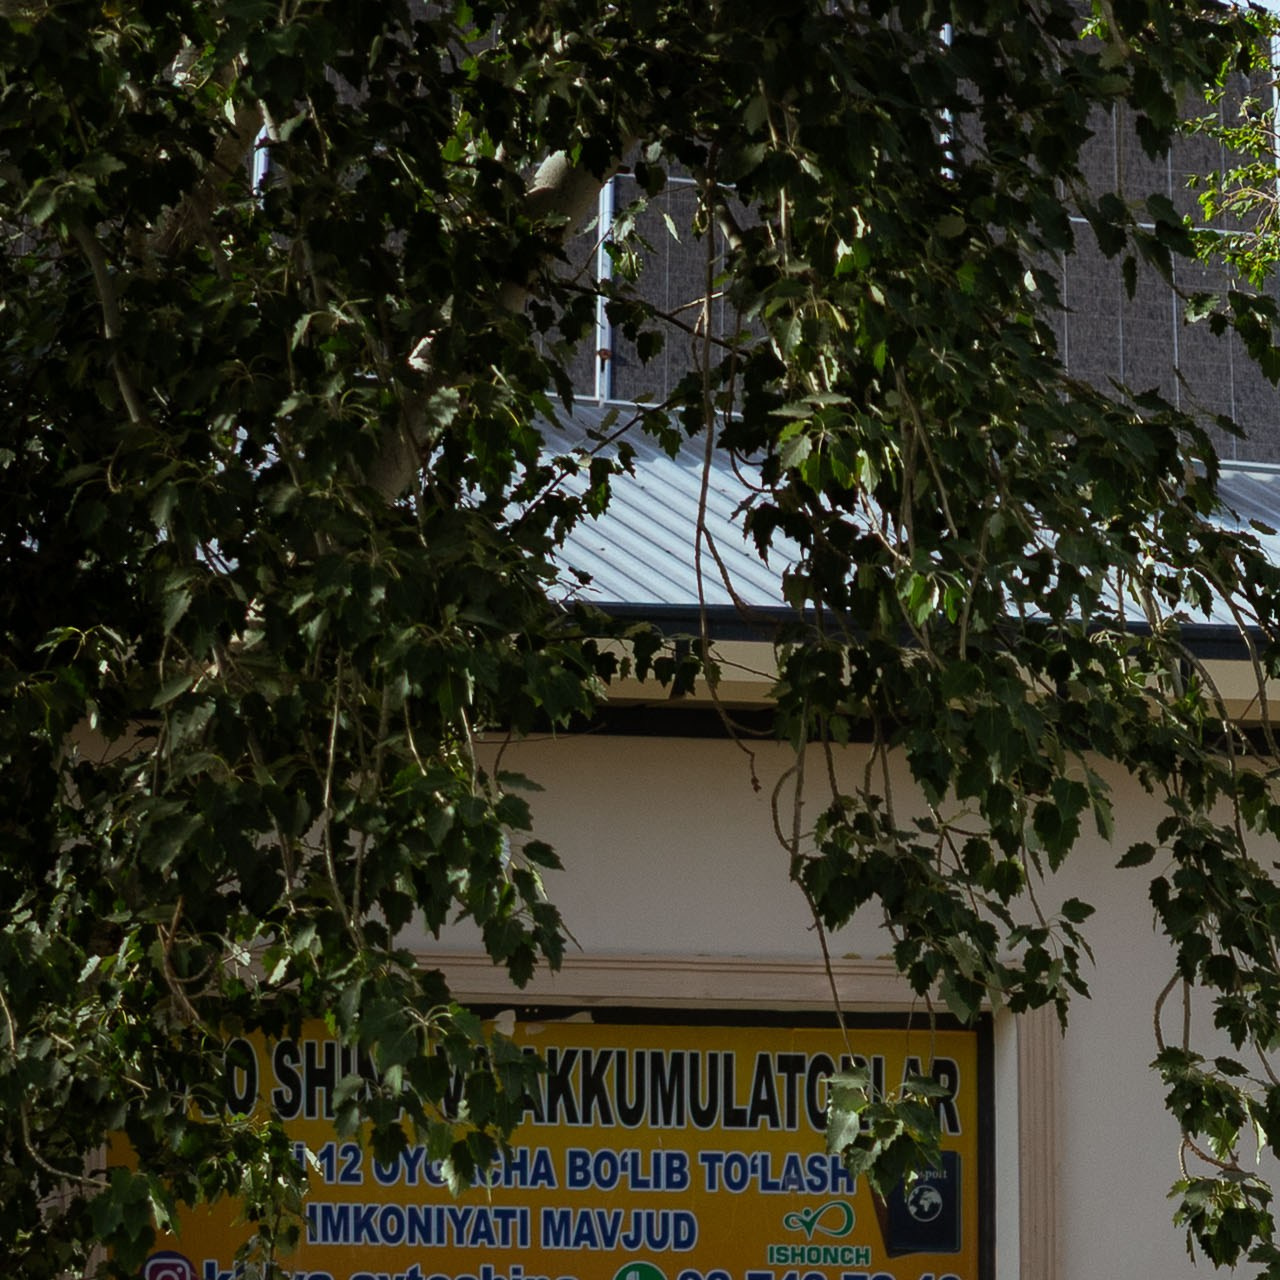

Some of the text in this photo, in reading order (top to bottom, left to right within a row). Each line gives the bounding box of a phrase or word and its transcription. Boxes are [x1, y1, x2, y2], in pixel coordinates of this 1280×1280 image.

[318, 1141, 362, 1187] 12
[306, 1202, 699, 1252] IMKONIYATI MAVJUD
[768, 1244, 871, 1266] ISHONCH
